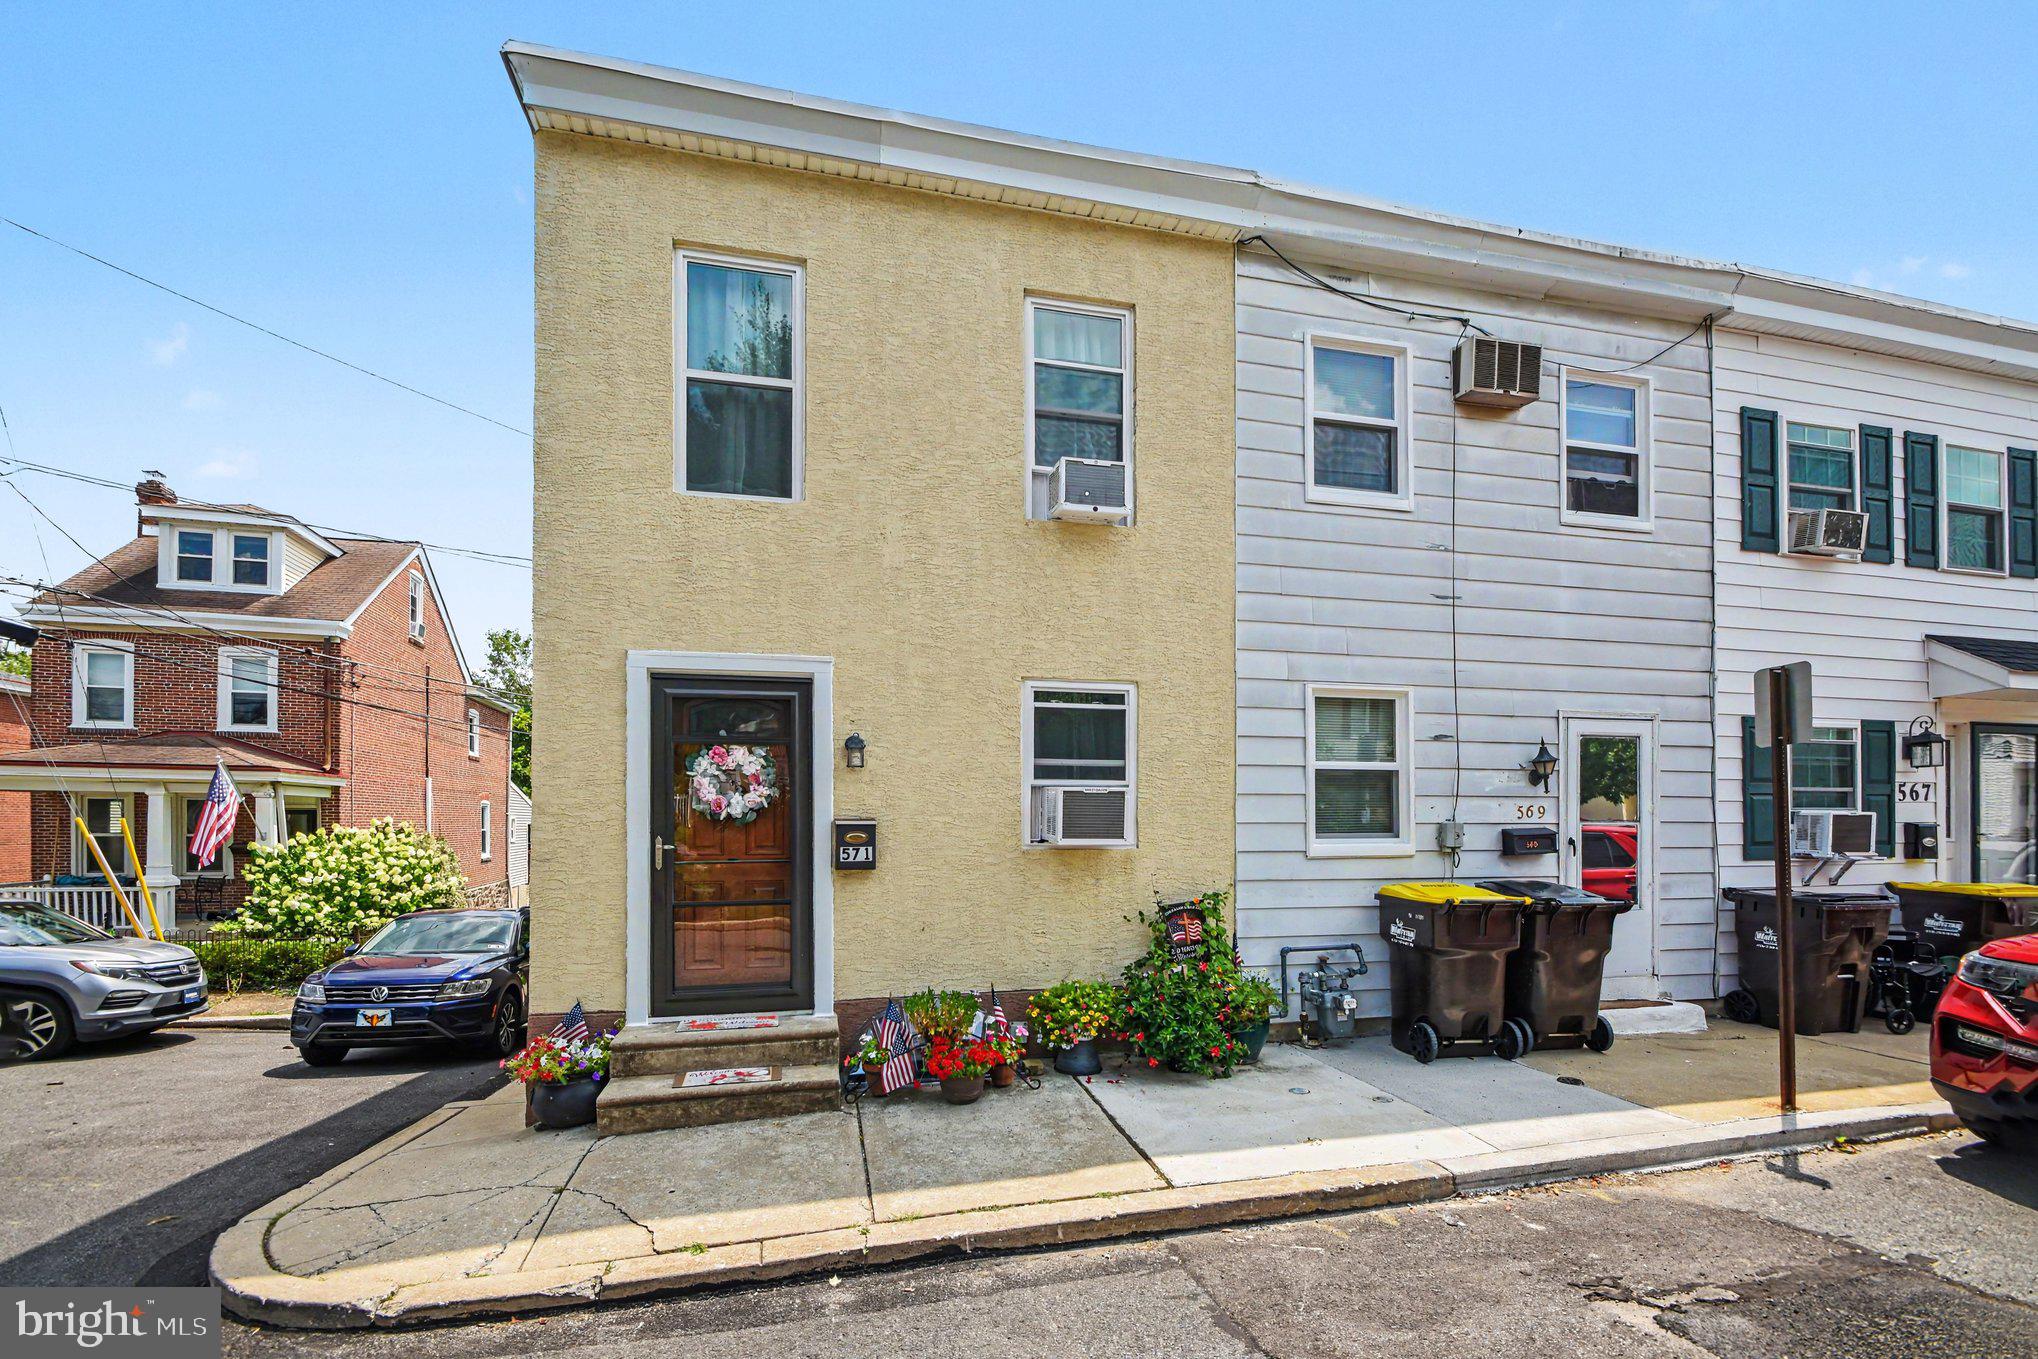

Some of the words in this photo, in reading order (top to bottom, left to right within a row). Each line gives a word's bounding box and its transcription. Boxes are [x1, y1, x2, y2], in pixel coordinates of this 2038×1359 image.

[1898, 782, 1931, 801] 567
[1517, 805, 1546, 819] 569
[842, 848, 870, 860] 571
